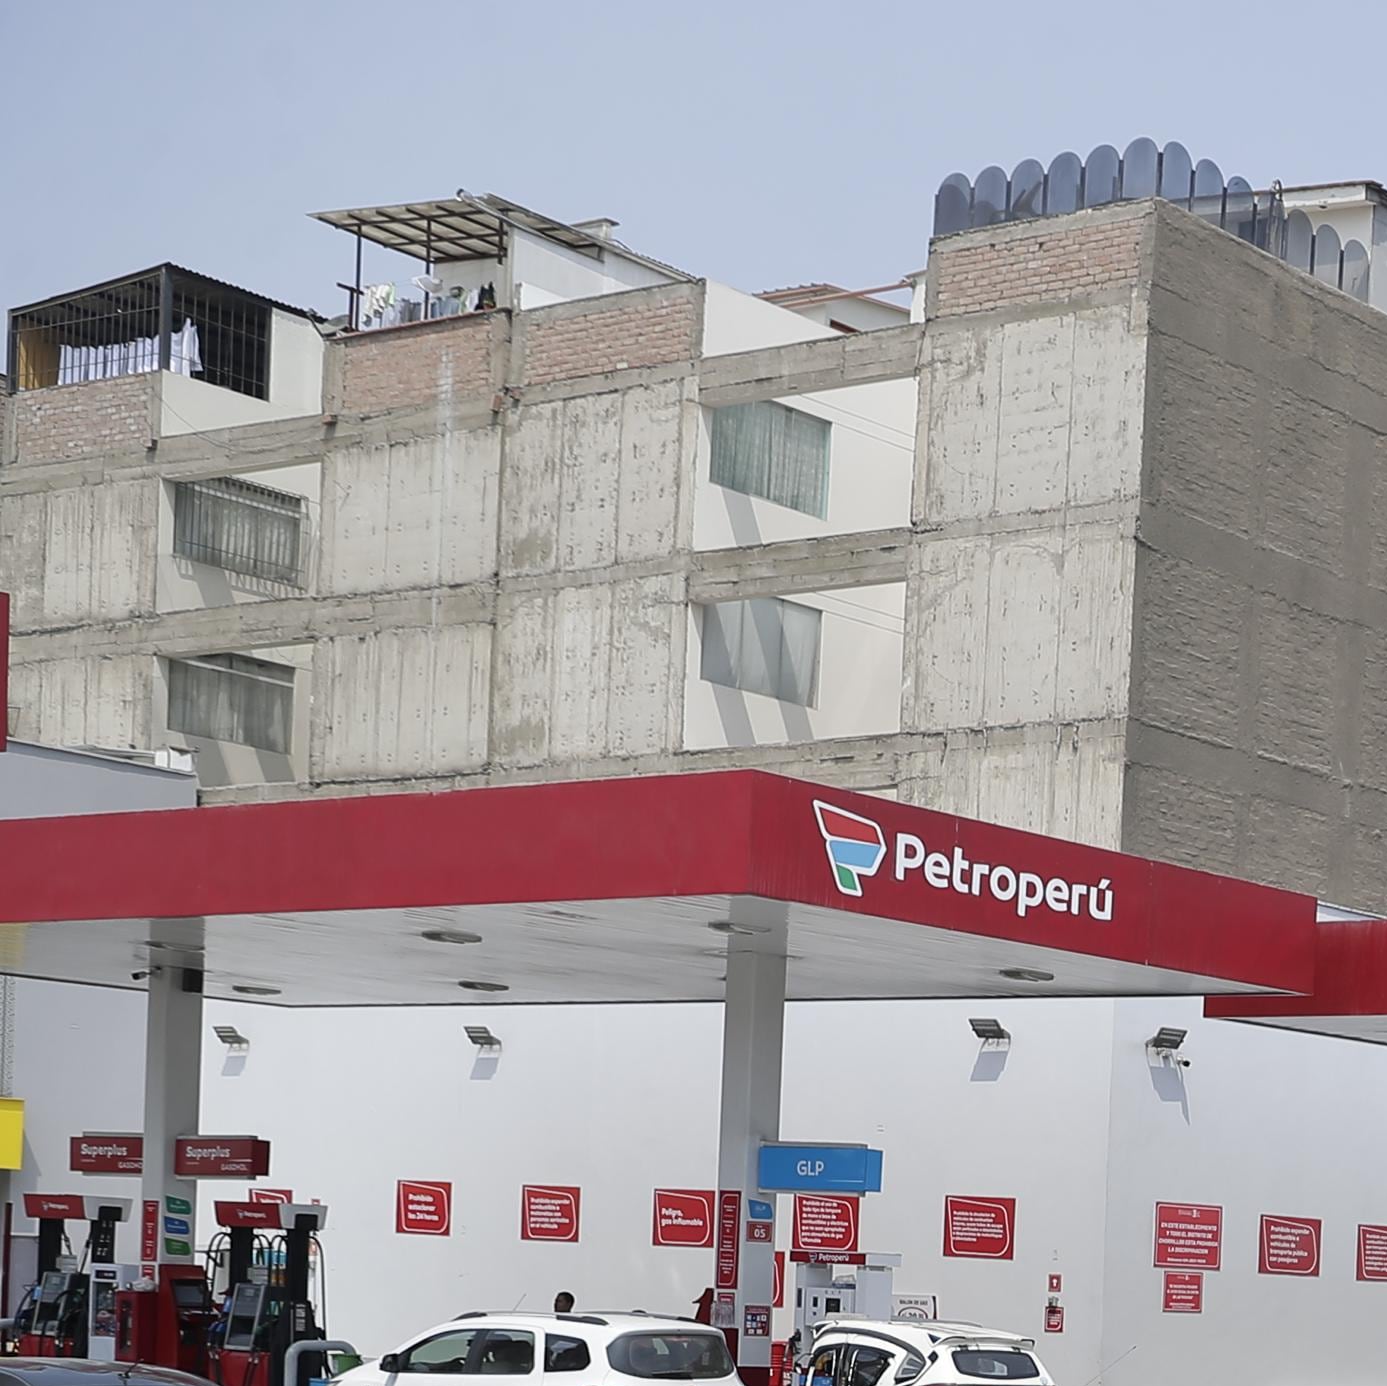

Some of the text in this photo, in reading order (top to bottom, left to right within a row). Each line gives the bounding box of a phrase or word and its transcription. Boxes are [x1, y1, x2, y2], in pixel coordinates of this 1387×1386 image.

[894, 832, 1113, 921] Petroperú
[81, 1144, 127, 1158] Superplus
[186, 1146, 230, 1160] Superplus
[797, 1161, 824, 1175] GLP
[753, 1228, 766, 1238] 05
[819, 1252, 849, 1262] Petroperú
